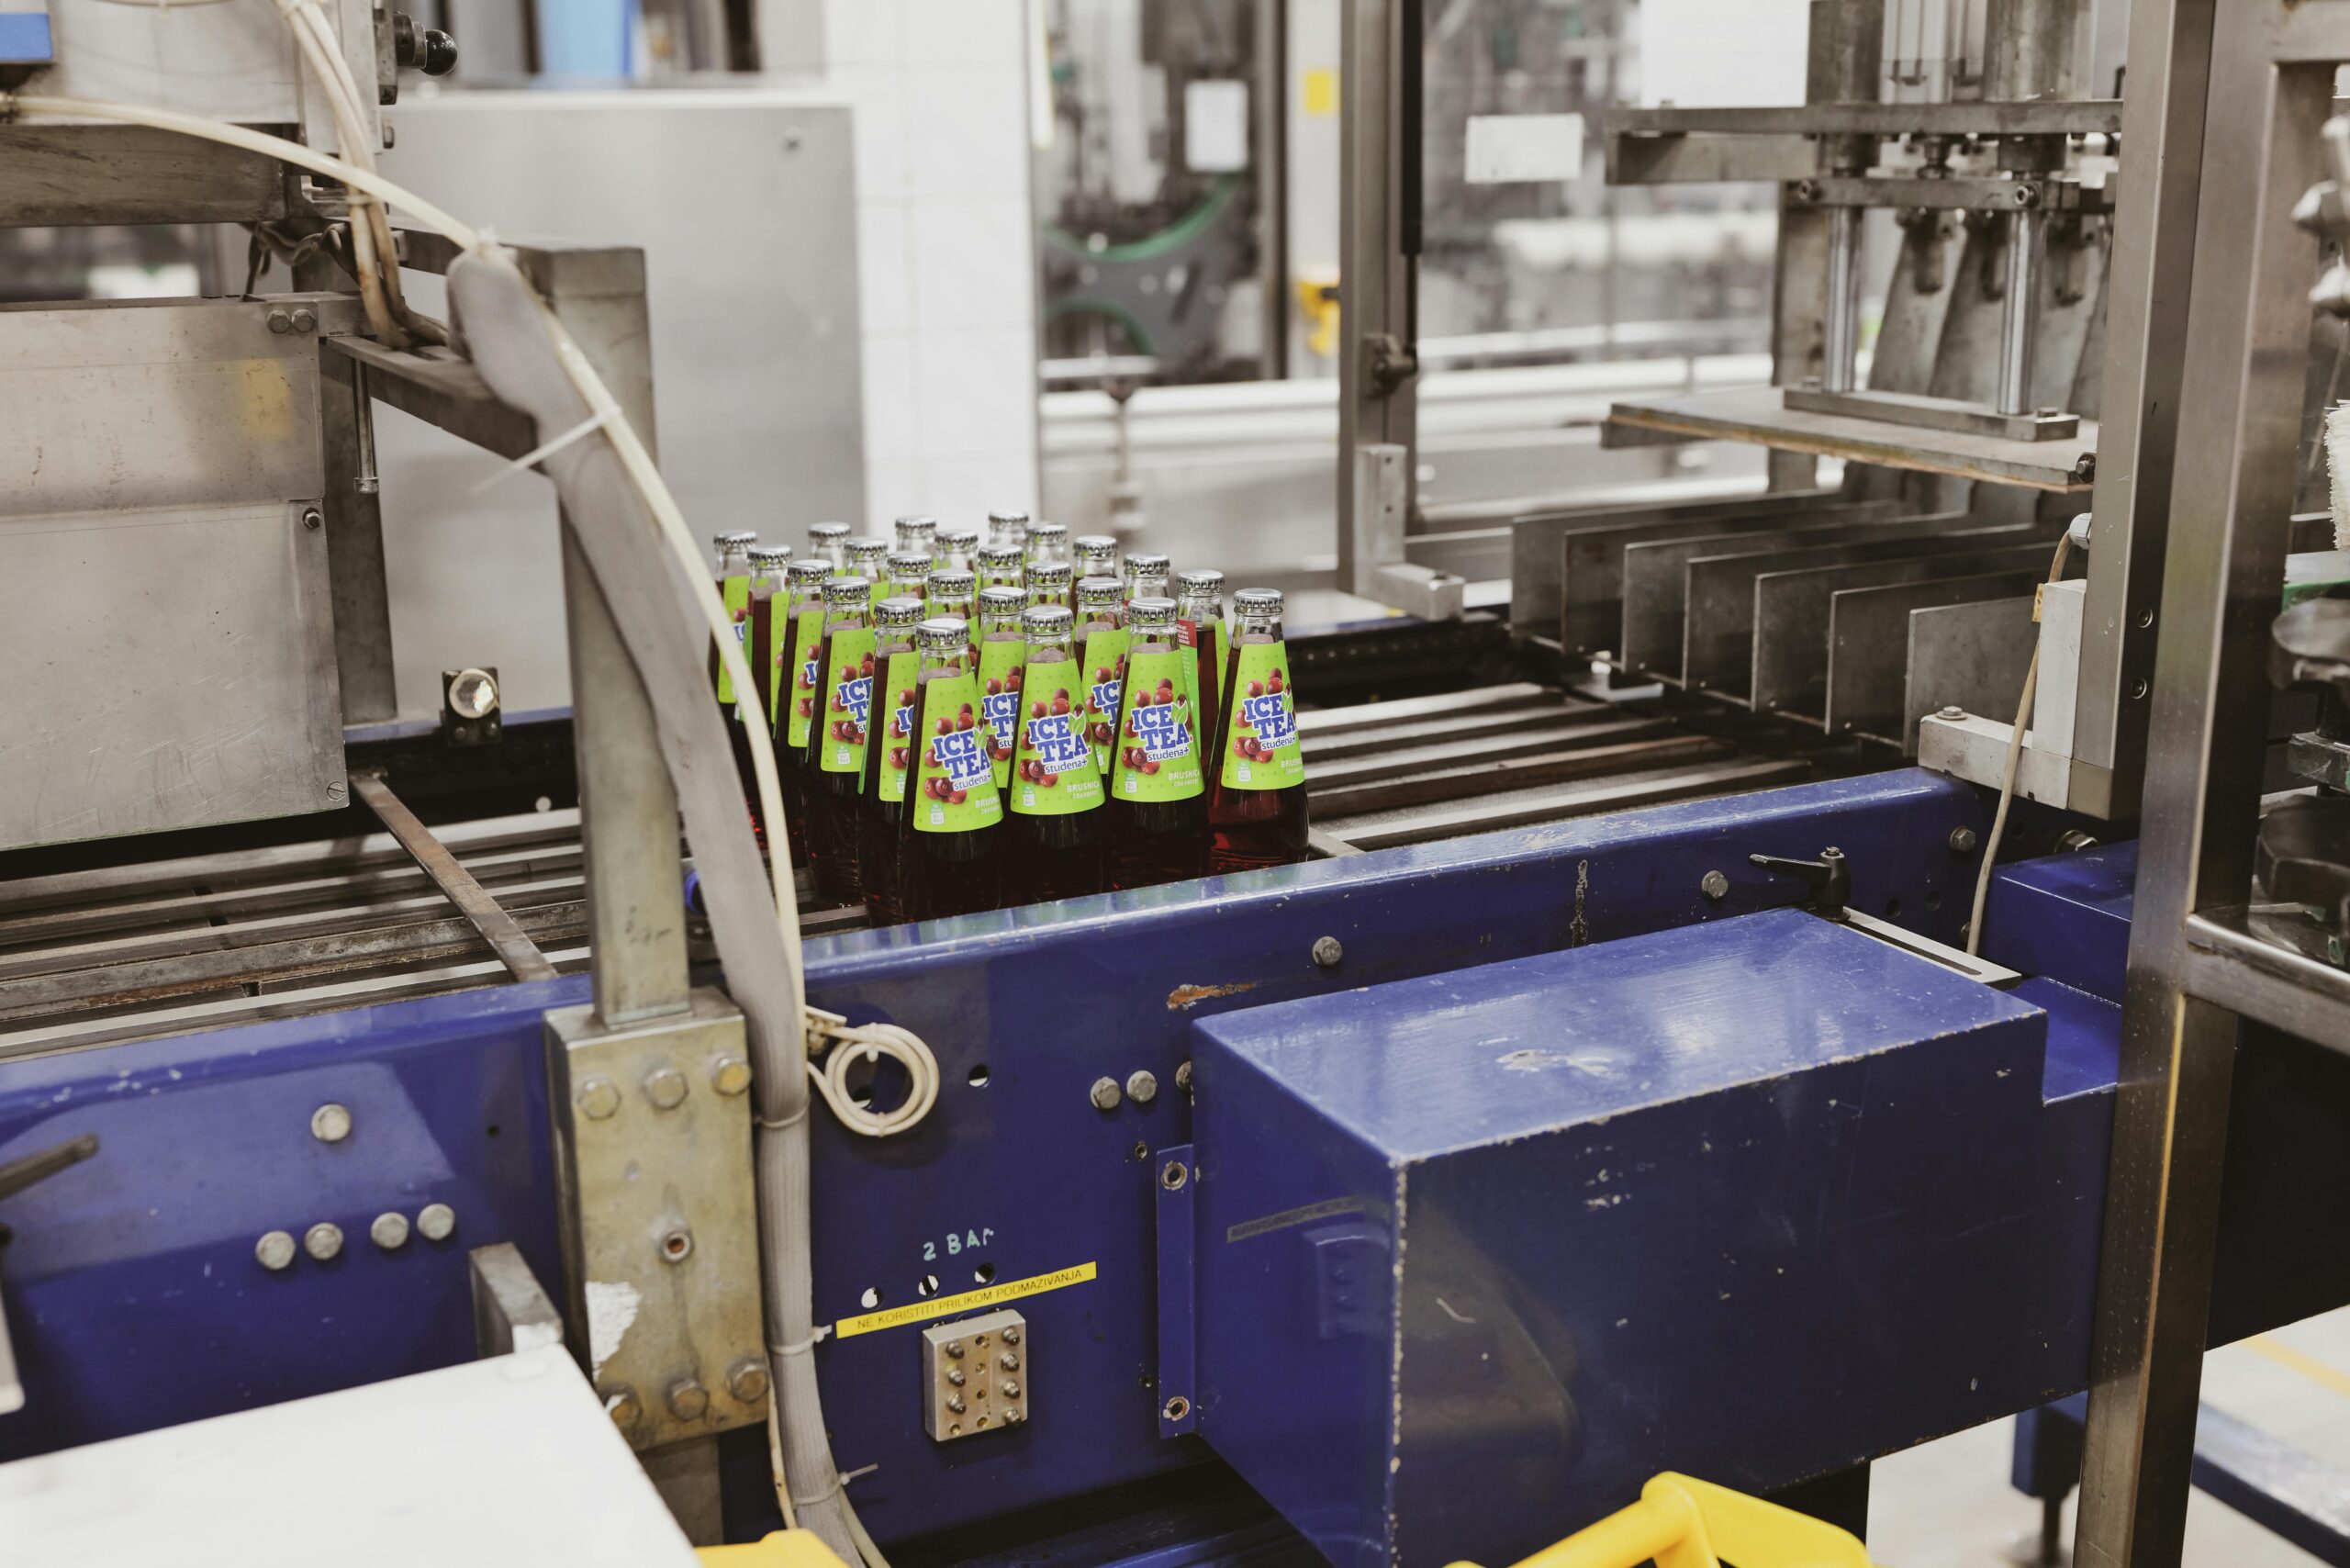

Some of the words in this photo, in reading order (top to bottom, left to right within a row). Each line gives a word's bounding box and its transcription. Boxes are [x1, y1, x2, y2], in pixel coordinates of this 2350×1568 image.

[1092, 682, 1121, 706] IC
[1131, 704, 1173, 731] ICE
[1244, 695, 1284, 722] ICE
[1028, 715, 1069, 743] ICE
[933, 730, 975, 759] ICE
[944, 750, 991, 779] TEA
[923, 1241, 936, 1261] 2
[857, 1318, 874, 1330] NE
[878, 1305, 934, 1325] KORISTITI
[938, 1291, 992, 1312] PRILIKOM
[996, 1269, 1082, 1298] PODMAZIVANJA
